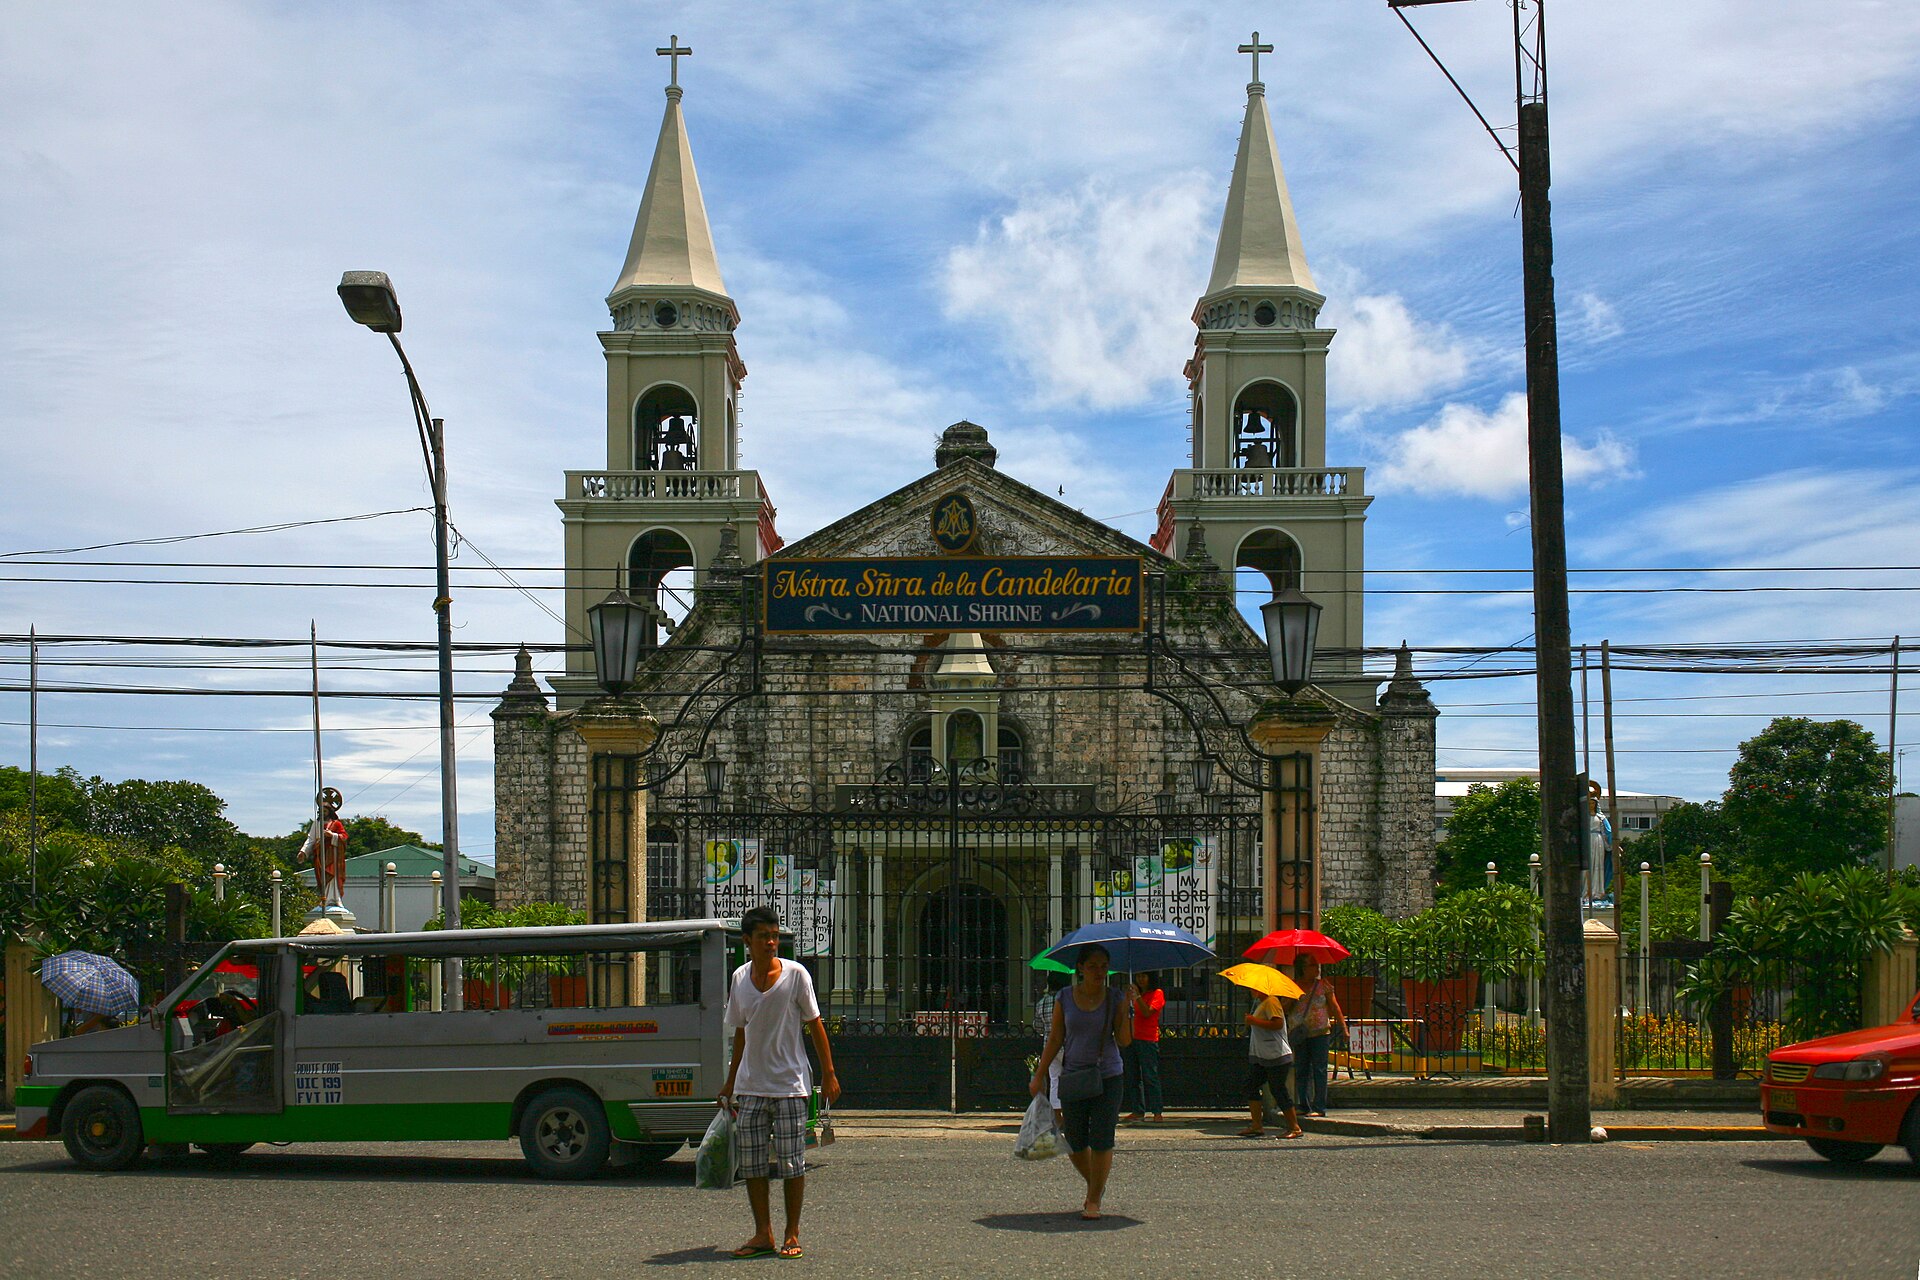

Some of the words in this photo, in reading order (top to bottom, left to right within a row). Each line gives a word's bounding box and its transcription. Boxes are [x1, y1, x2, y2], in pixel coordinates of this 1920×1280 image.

[772, 569, 850, 599] Nstra.
[855, 567, 926, 597] Sñra.
[981, 566, 1134, 597] Candelaria
[861, 603, 963, 623] NATIONAL
[968, 603, 1042, 622] SHRINE
[1180, 876, 1200, 889] My
[715, 885, 754, 897] FAITH
[1171, 890, 1208, 902] LORD
[712, 899, 755, 908] without
[1169, 904, 1190, 914] and
[297, 1063, 320, 1074] ROUTE
[321, 1063, 341, 1074] CODE
[322, 1077, 341, 1089] 199
[297, 1092, 320, 1104] FVT
[325, 1092, 341, 1103] 117
